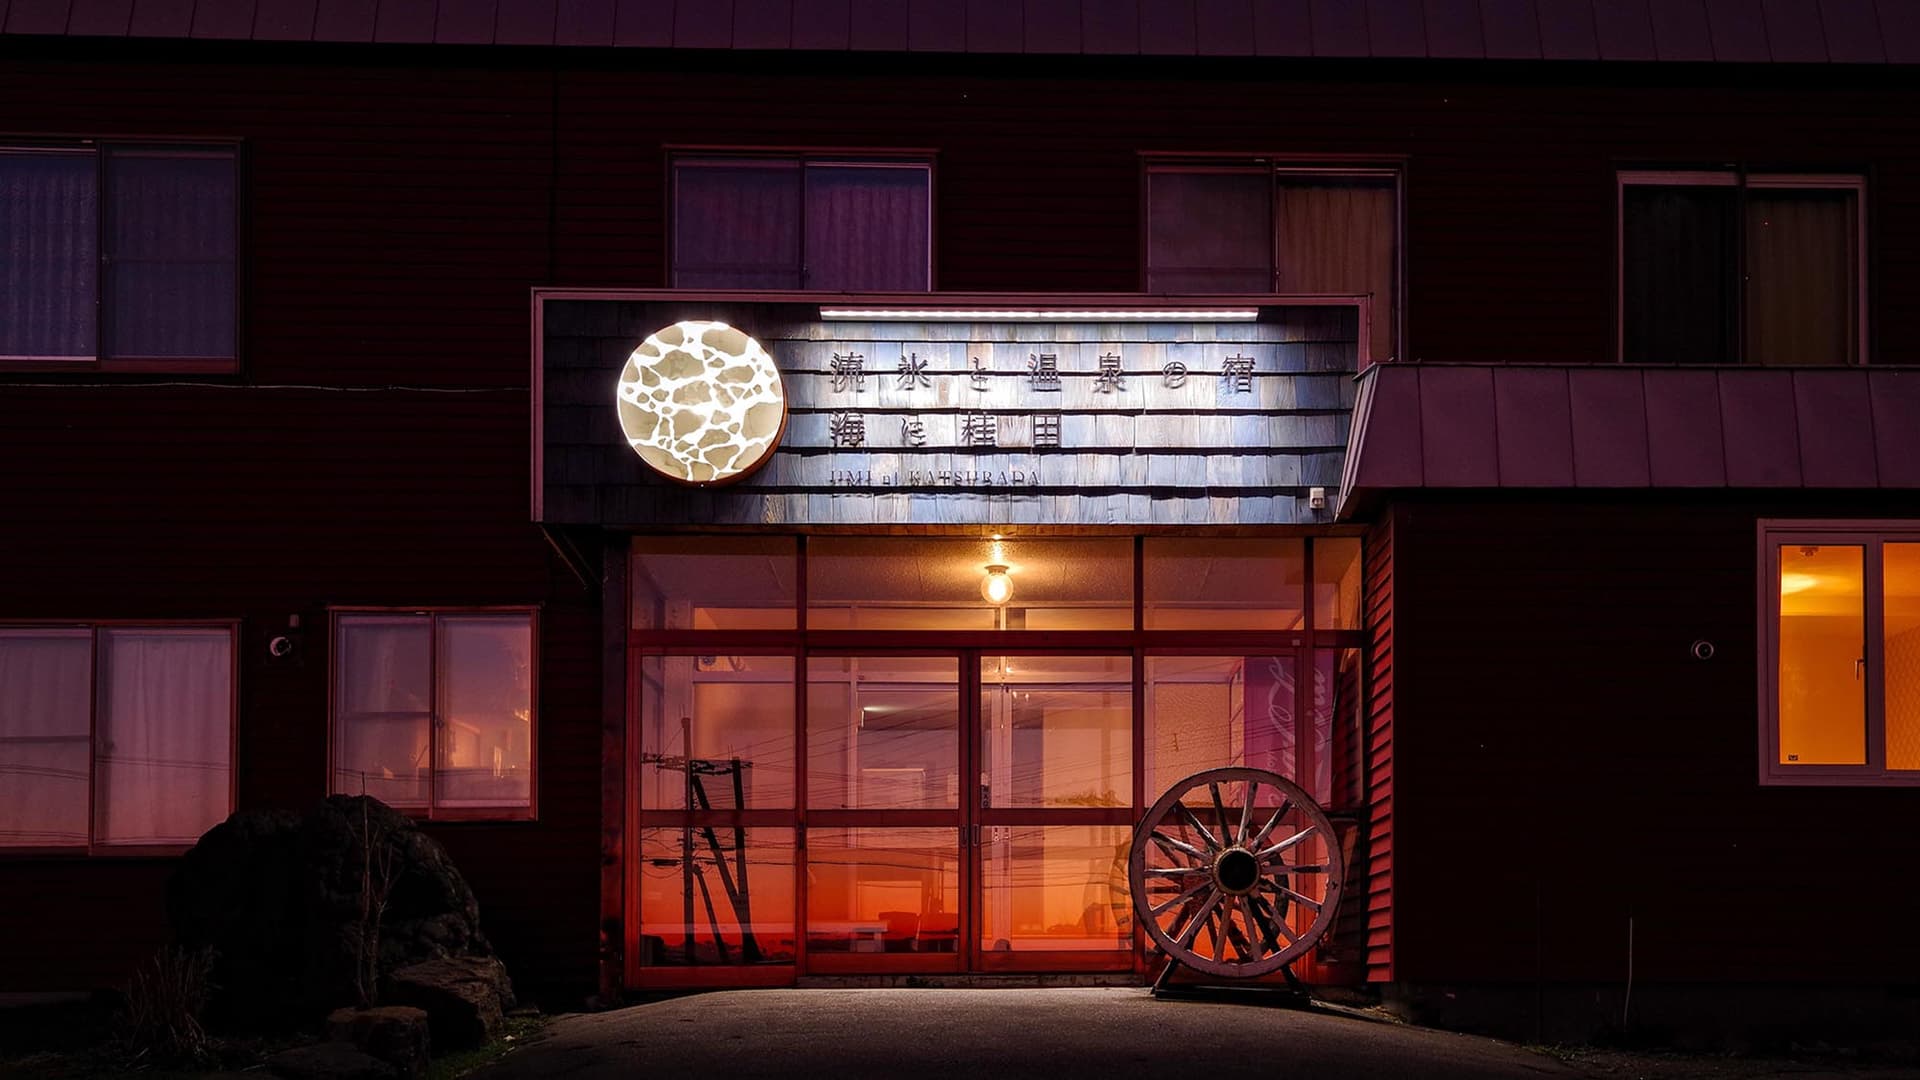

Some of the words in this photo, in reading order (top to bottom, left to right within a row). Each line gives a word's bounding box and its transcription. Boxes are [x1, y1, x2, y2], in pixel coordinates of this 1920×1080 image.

[830, 352, 1256, 391] 流氷と温泉の宿
[830, 411, 1061, 448] 海に桂田
[829, 470, 871, 486] UMI
[909, 470, 1040, 486] KATSURADA
